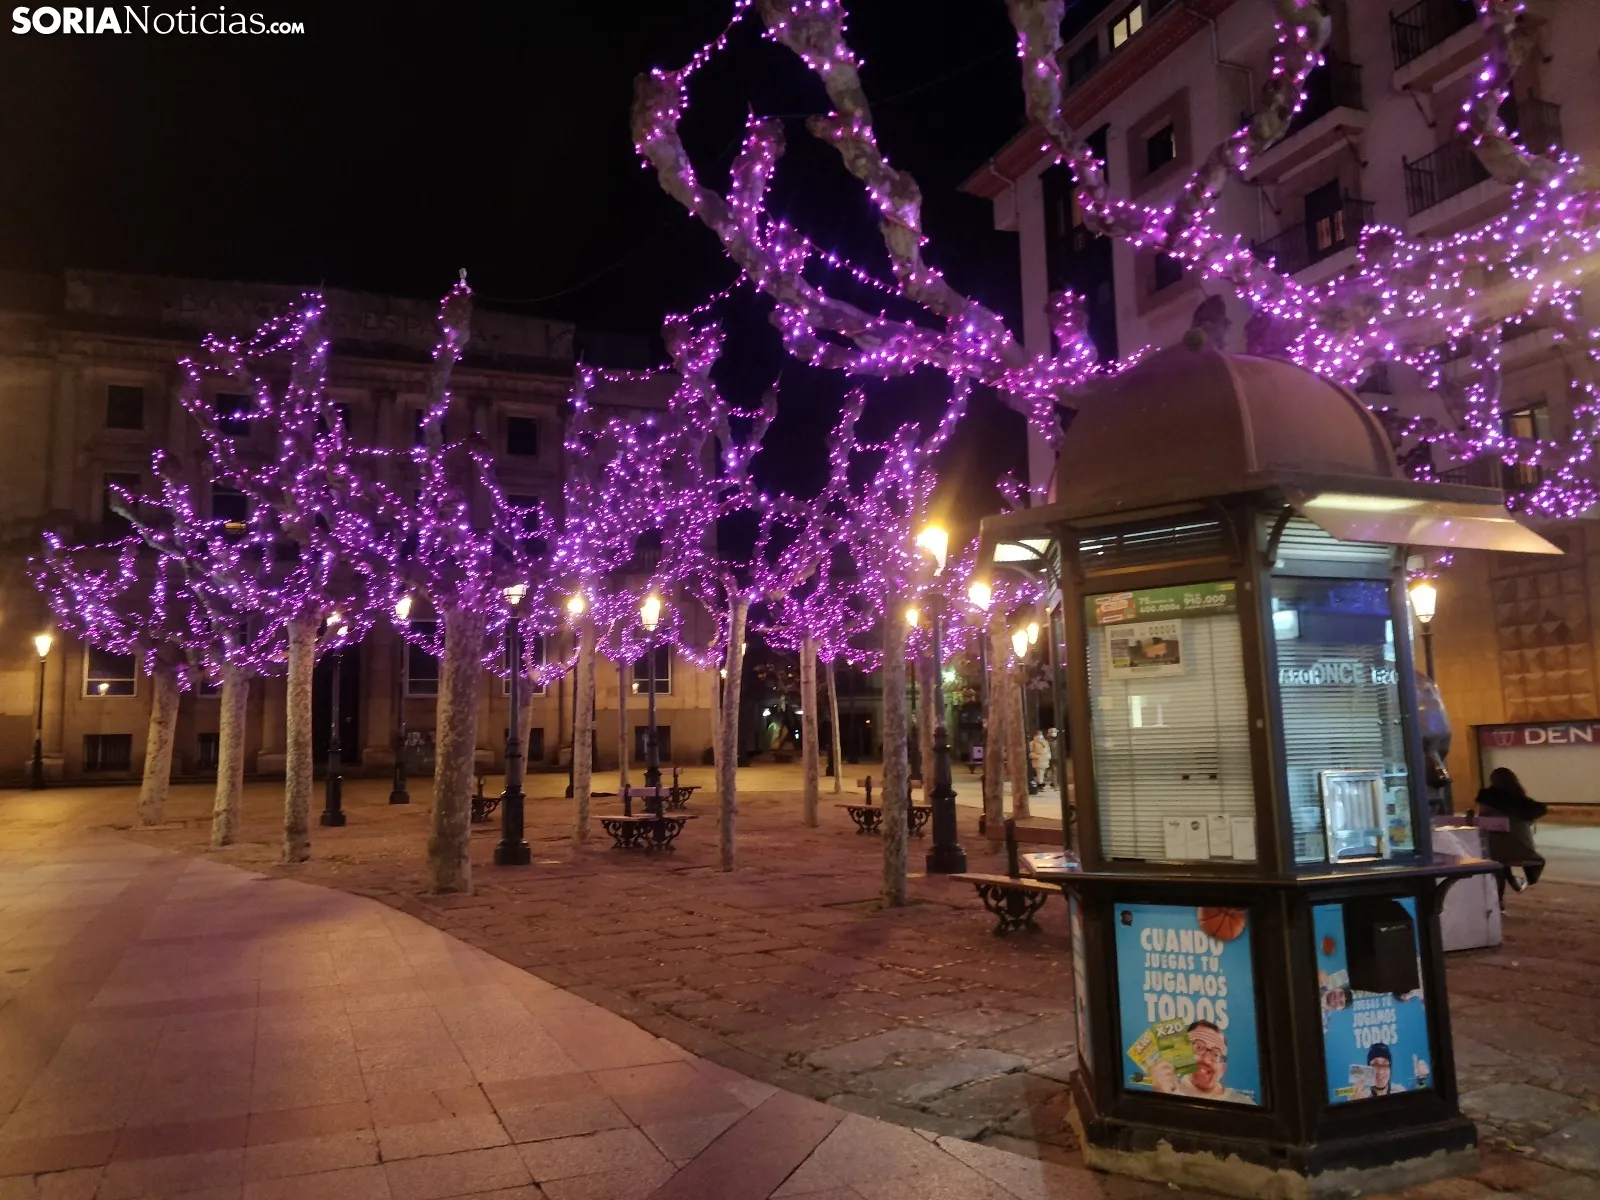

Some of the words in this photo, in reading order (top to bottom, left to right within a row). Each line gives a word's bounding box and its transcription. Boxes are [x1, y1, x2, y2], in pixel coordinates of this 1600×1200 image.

[1311, 662, 1366, 684] ONCE
[1140, 927, 1224, 956] CUANDO
[1143, 952, 1195, 971] JUEGAS
[1142, 970, 1228, 997] JUGAMOS
[1144, 993, 1229, 1030] TODOS
[1352, 1008, 1397, 1028] JUGAMOS
[1353, 1023, 1398, 1048] TODOS
